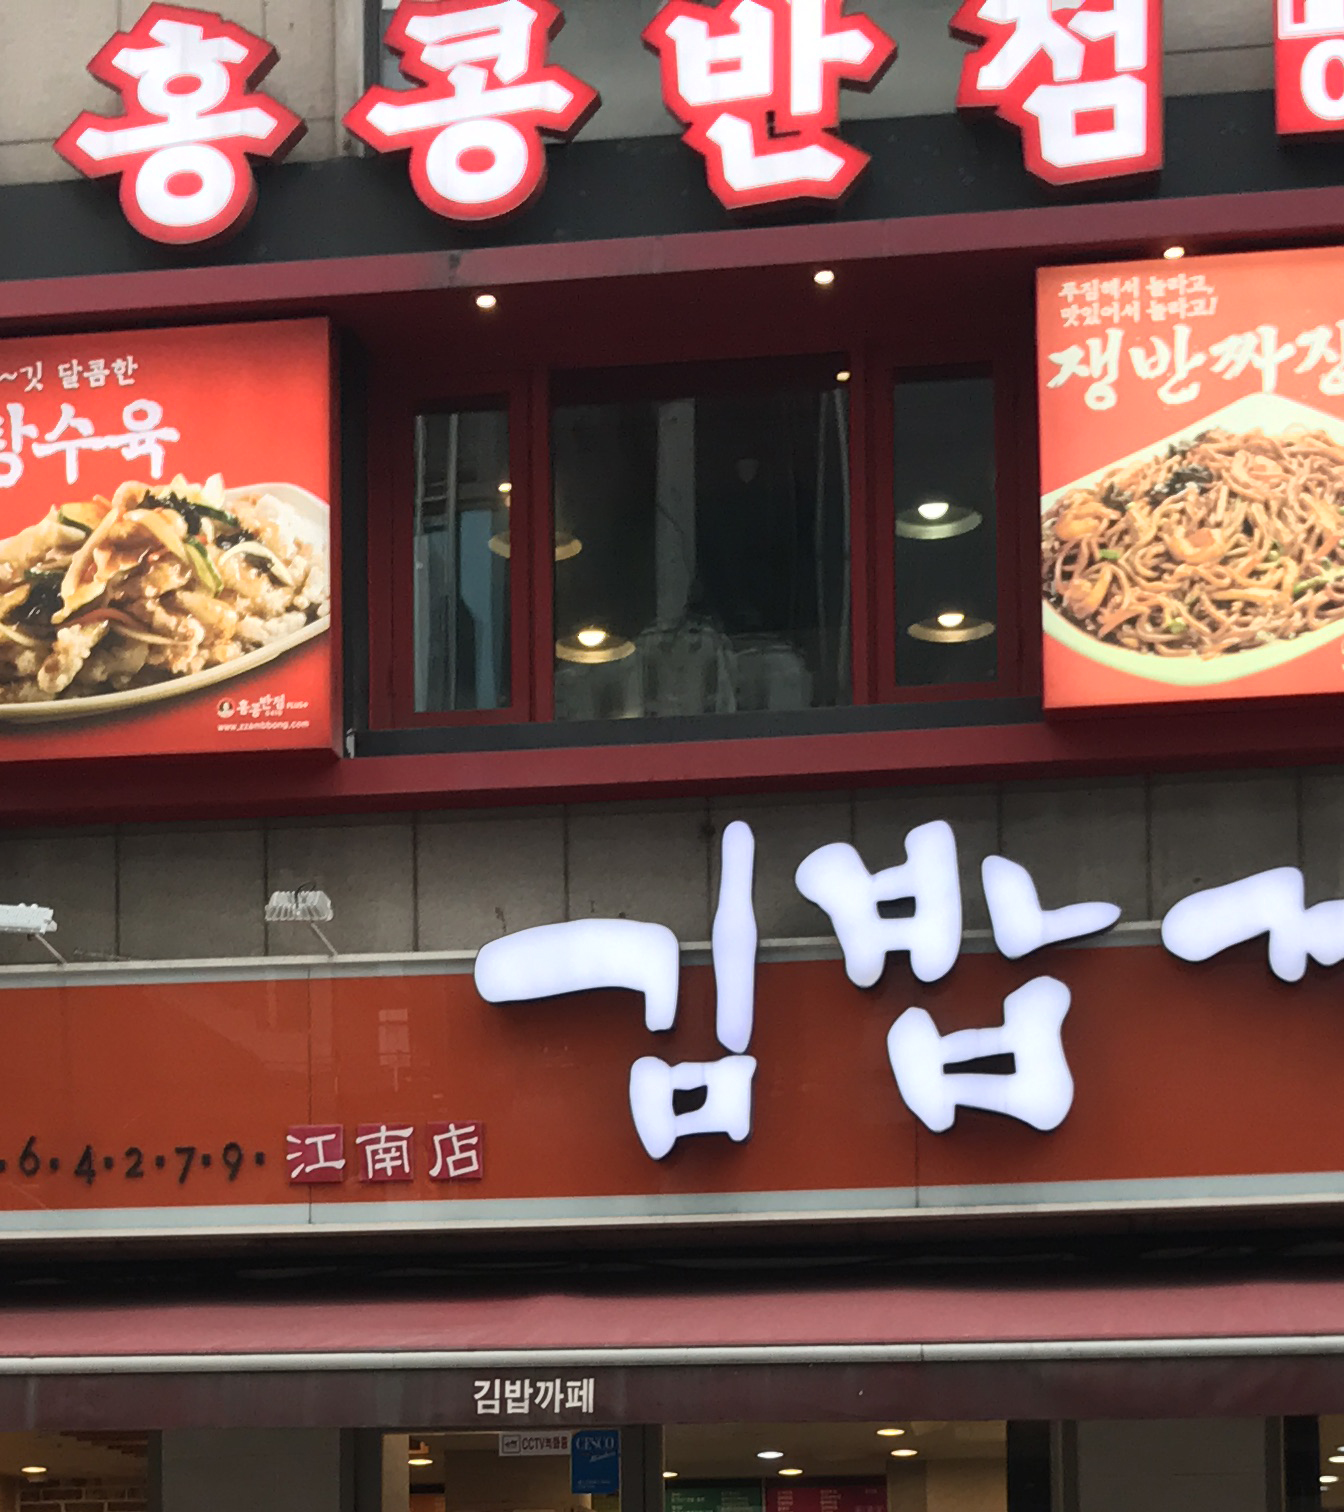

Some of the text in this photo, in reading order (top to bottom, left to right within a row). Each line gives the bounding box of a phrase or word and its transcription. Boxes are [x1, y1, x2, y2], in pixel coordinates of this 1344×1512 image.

[68, 0, 1152, 230] 홍콩반점
[1059, 299, 1141, 328] 맛있어서
[57, 354, 139, 389] 달콤한
[285, 1122, 484, 1182] 江南店
[473, 1377, 596, 1415] 김밥까페
